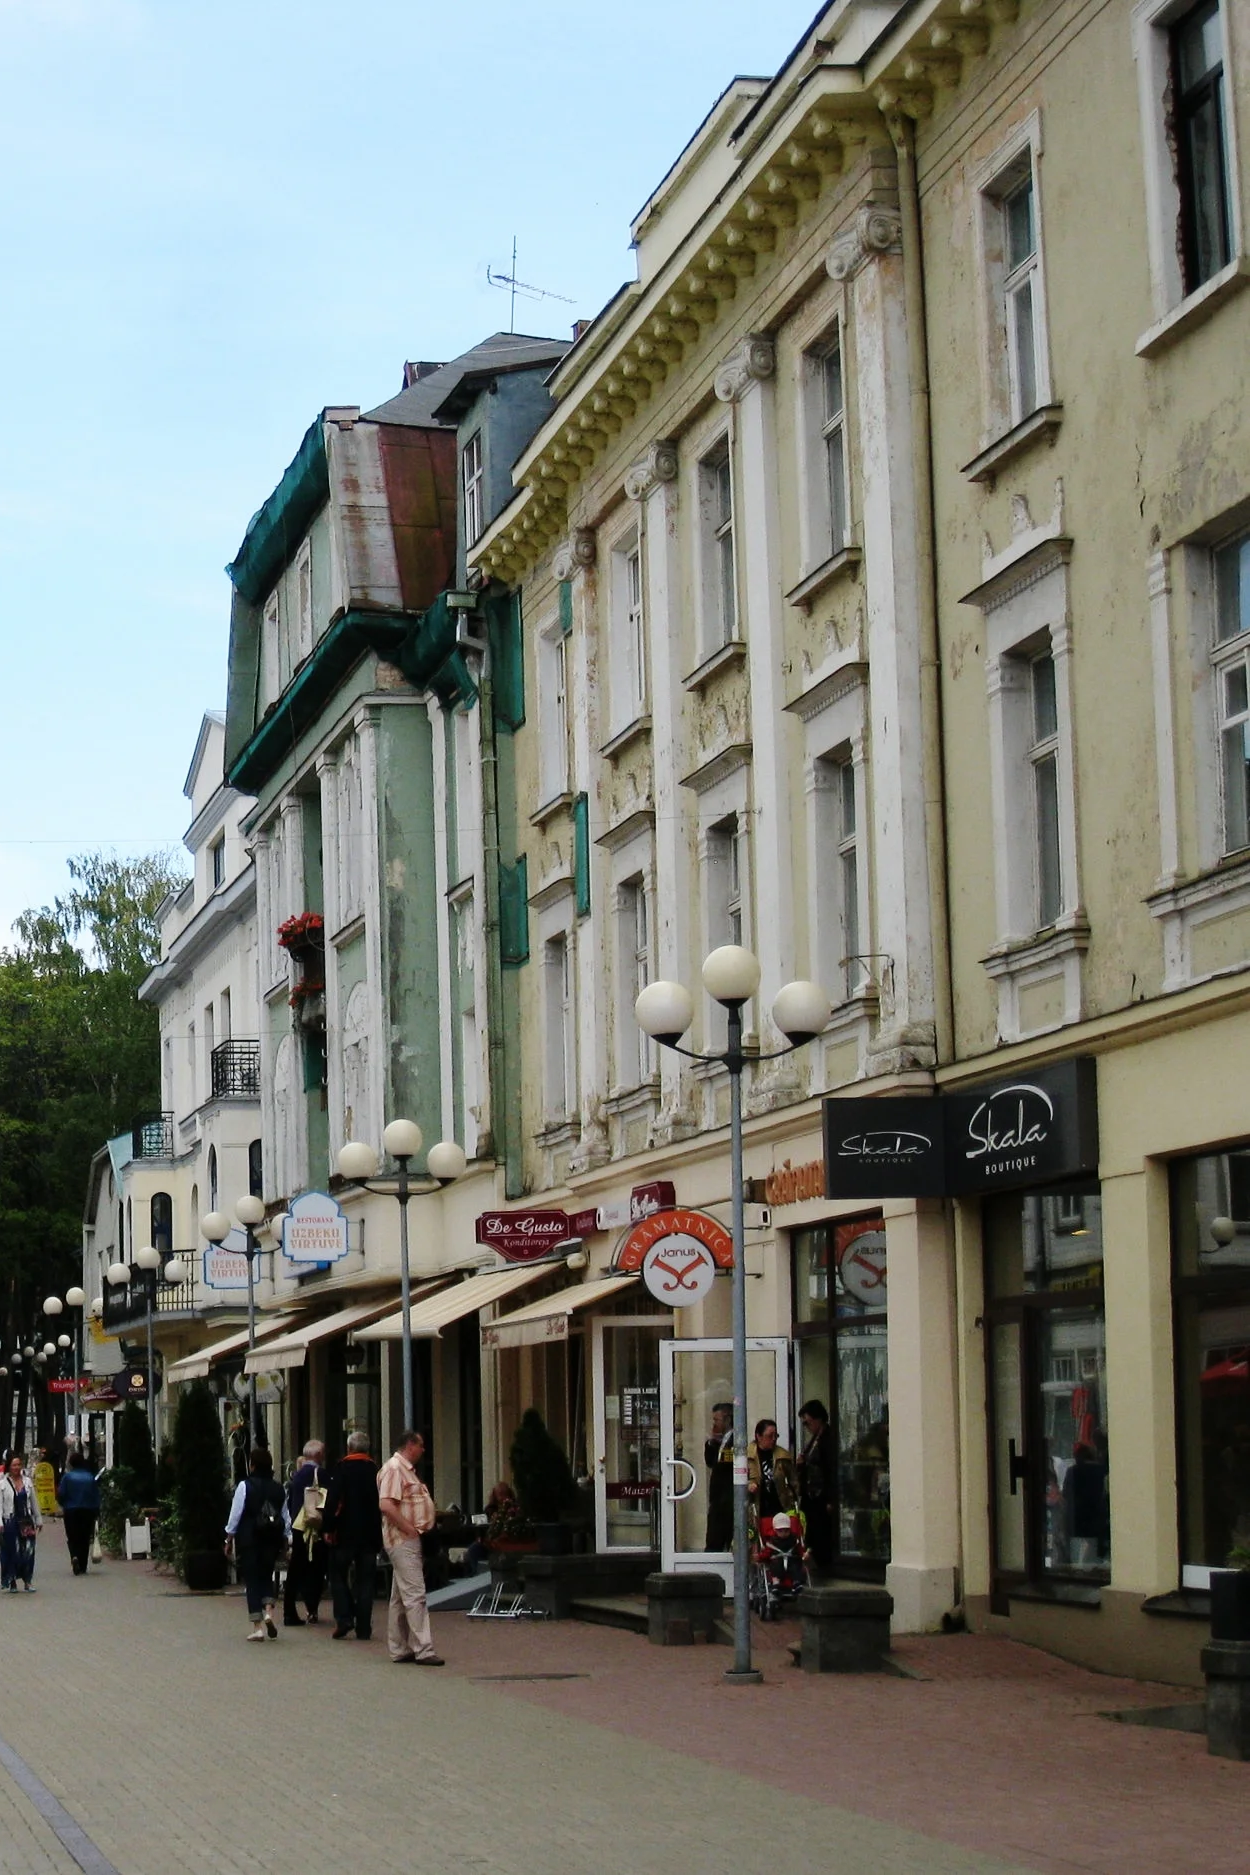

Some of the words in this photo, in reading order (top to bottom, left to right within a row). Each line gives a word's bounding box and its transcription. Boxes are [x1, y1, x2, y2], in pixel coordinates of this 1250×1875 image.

[966, 1086, 1053, 1158] Skala
[838, 1132, 931, 1156] Skala
[985, 1155, 1037, 1175] BOUTIQUE
[486, 1219, 512, 1234] De
[515, 1218, 565, 1236] Gusto
[661, 1248, 696, 1257] Janus
